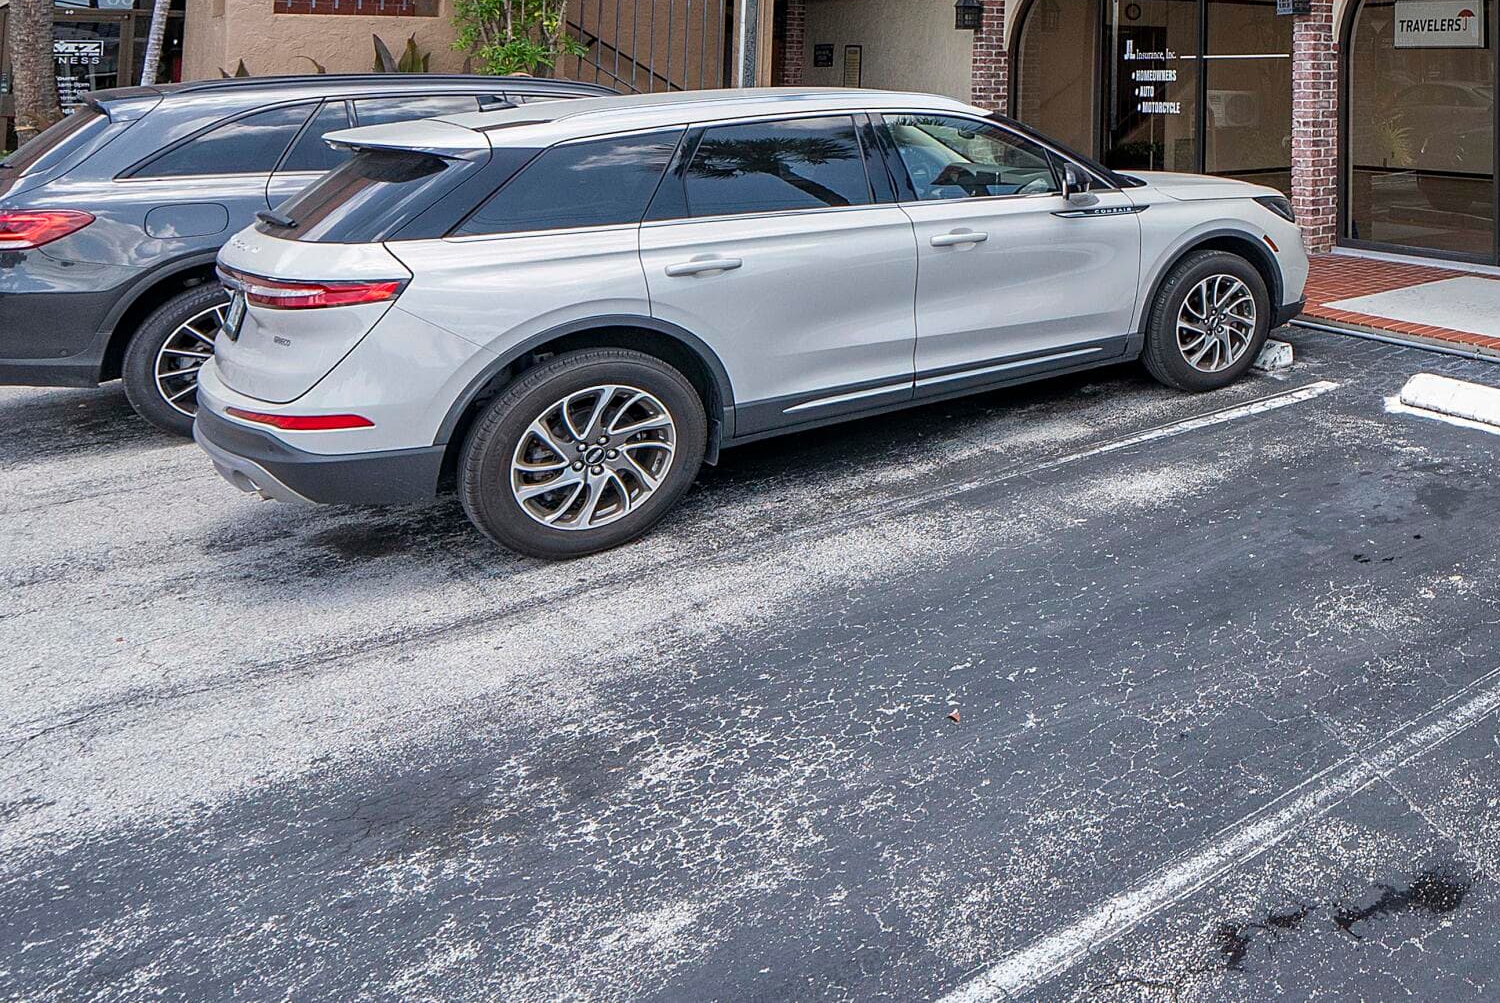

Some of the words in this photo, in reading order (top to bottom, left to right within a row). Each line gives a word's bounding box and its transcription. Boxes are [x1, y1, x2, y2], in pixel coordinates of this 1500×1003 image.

[1399, 18, 1462, 33] TRAVELERS
[54, 57, 101, 65] NESS
[1136, 48, 1165, 61] Insurance,
[1165, 48, 1177, 59] Inc.
[1135, 69, 1177, 82] HOMEOWNERS
[1139, 85, 1155, 98] AUTO
[1142, 101, 1181, 114] MOTORCYCLE
